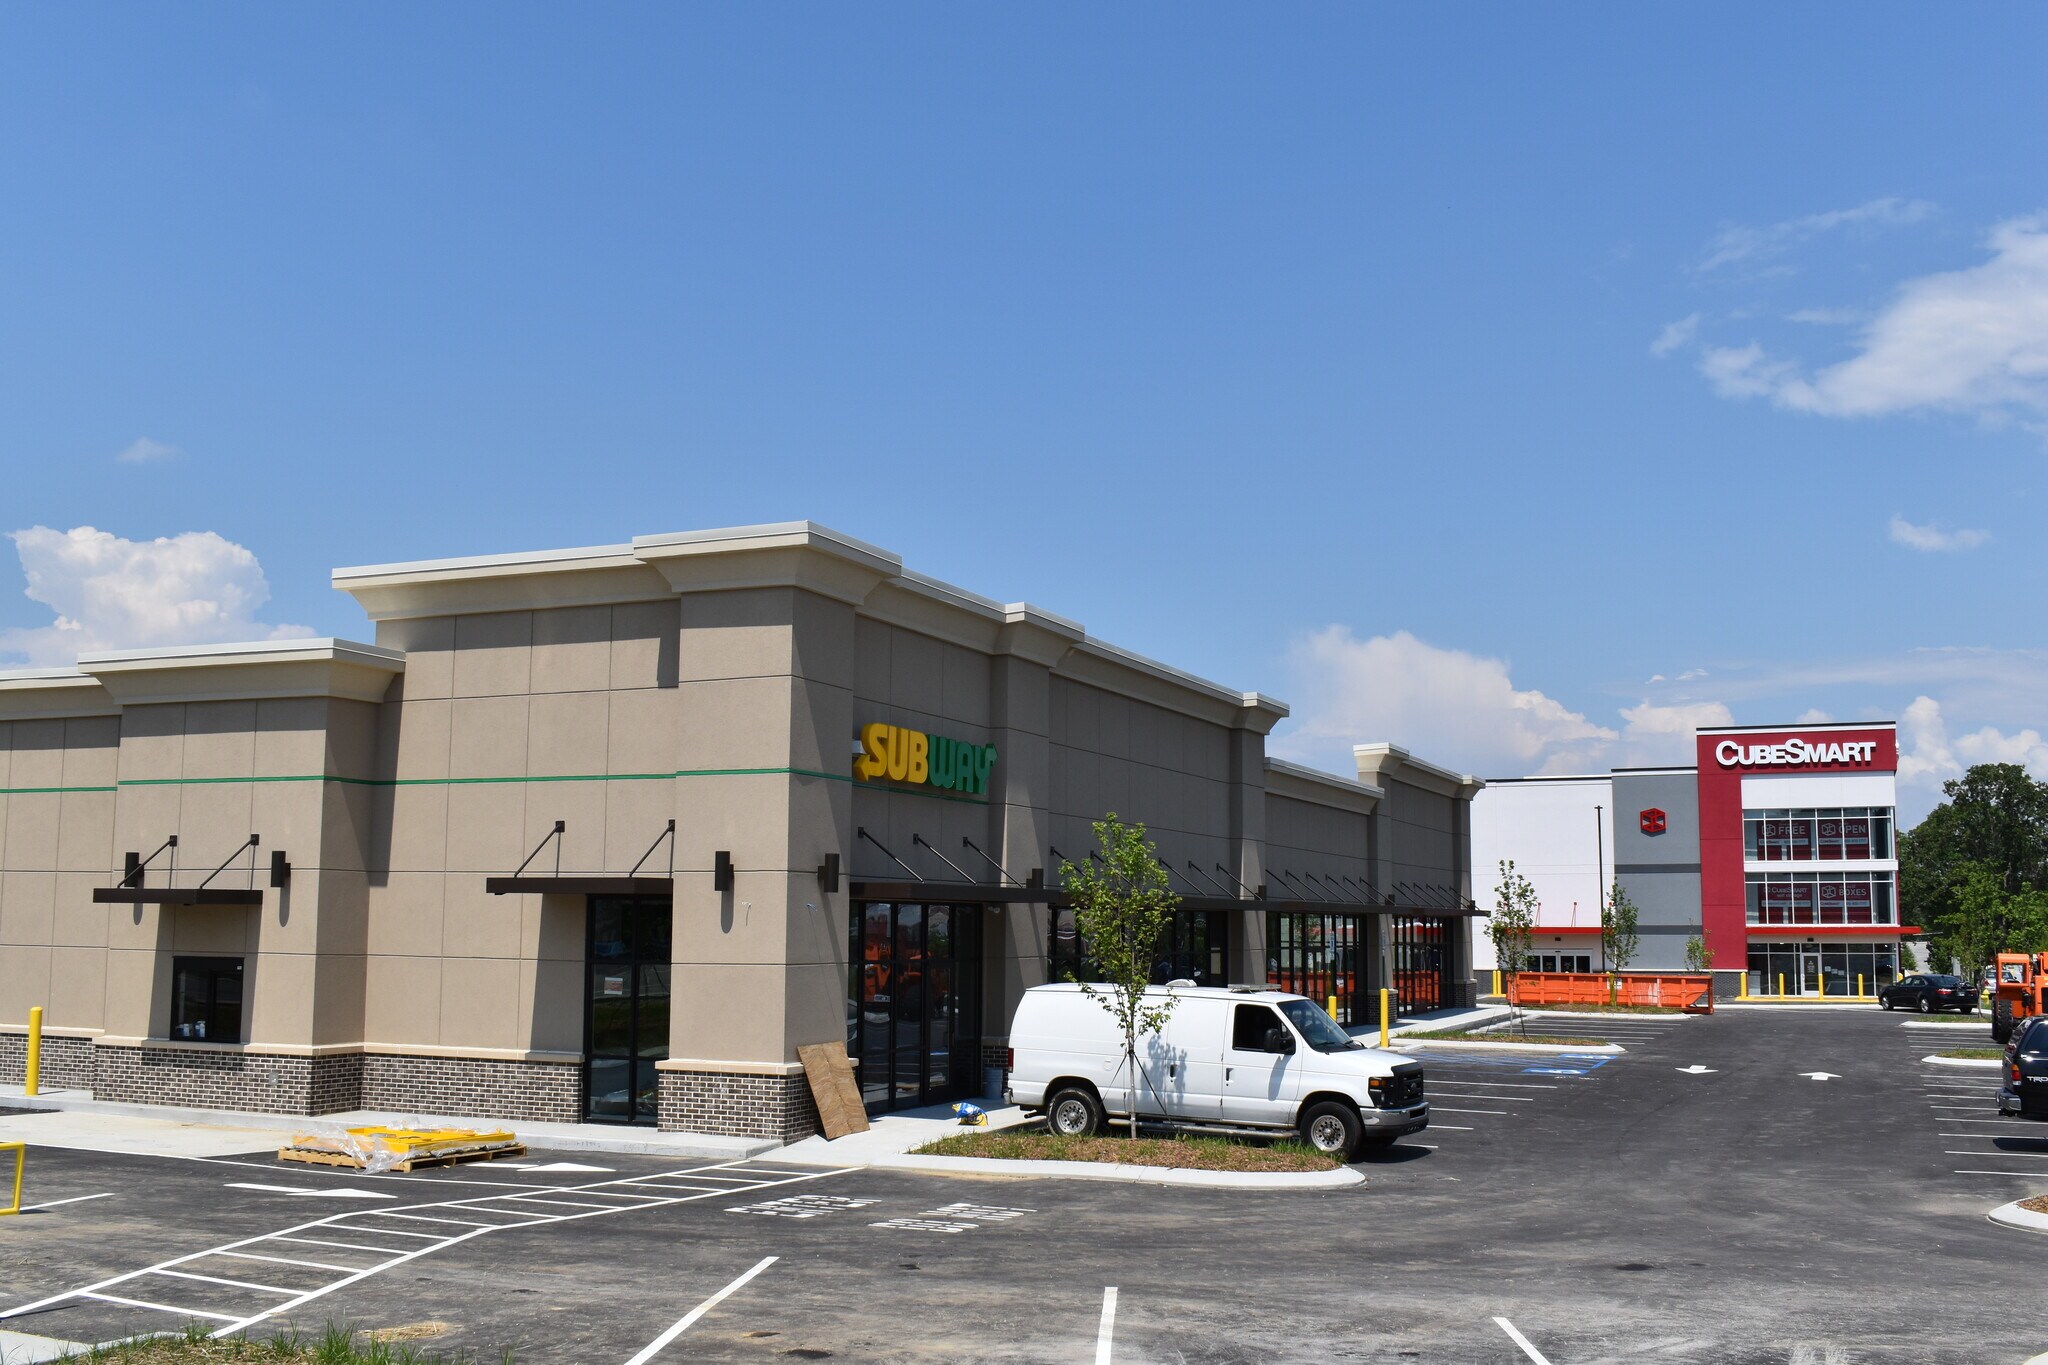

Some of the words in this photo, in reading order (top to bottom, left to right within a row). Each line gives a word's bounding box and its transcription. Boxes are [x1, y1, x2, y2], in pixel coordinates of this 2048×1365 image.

[853, 722, 998, 794] SUBWAY
[1778, 825, 1806, 835] FREE
[1838, 824, 1866, 834] OPEN
[1838, 888, 1867, 896] BOXES
